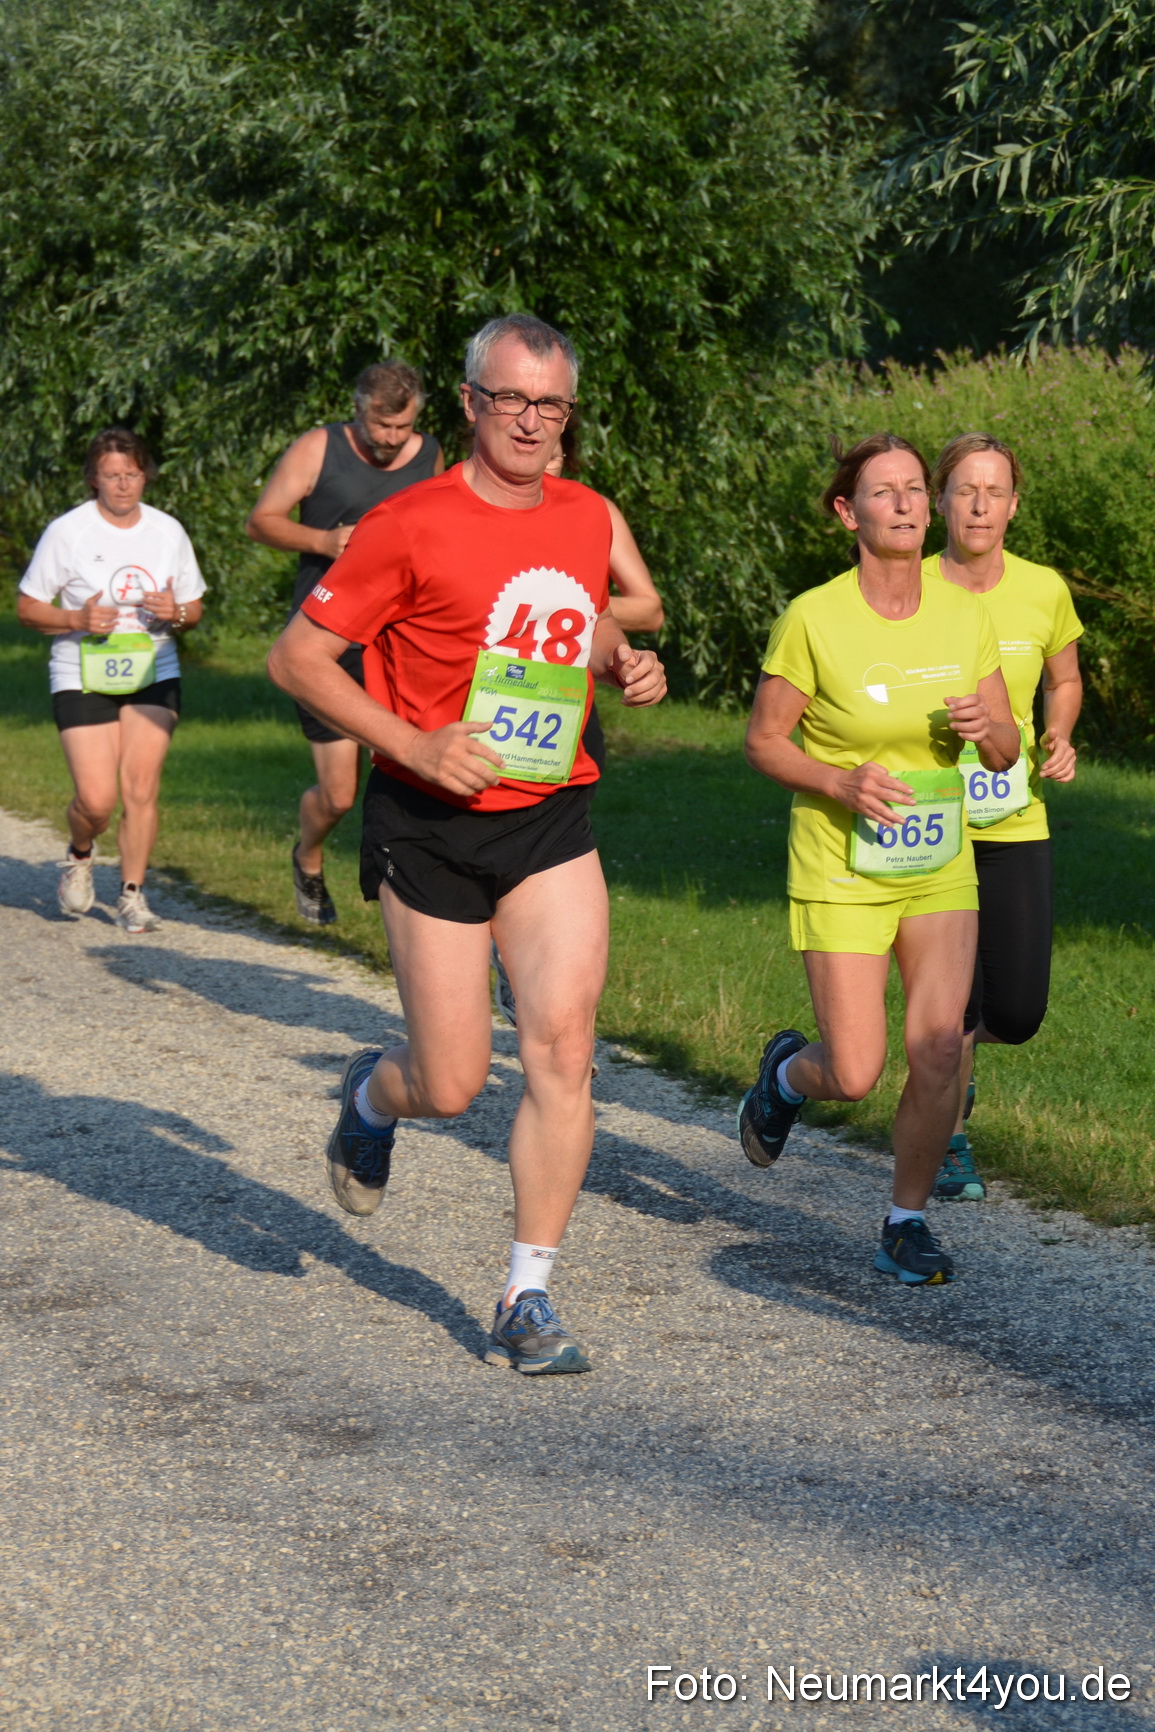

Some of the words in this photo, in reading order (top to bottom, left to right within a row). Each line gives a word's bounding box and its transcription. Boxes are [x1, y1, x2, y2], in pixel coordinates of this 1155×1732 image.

[496, 603, 586, 666] 48
[105, 659, 133, 678] 82
[489, 705, 562, 750] 542
[511, 753, 562, 767] Hammerbacher
[960, 770, 1011, 802] 66
[984, 807, 1005, 815] Simon
[877, 812, 944, 849] 665
[885, 855, 904, 864] Petra
[906, 853, 933, 863] Naubert
